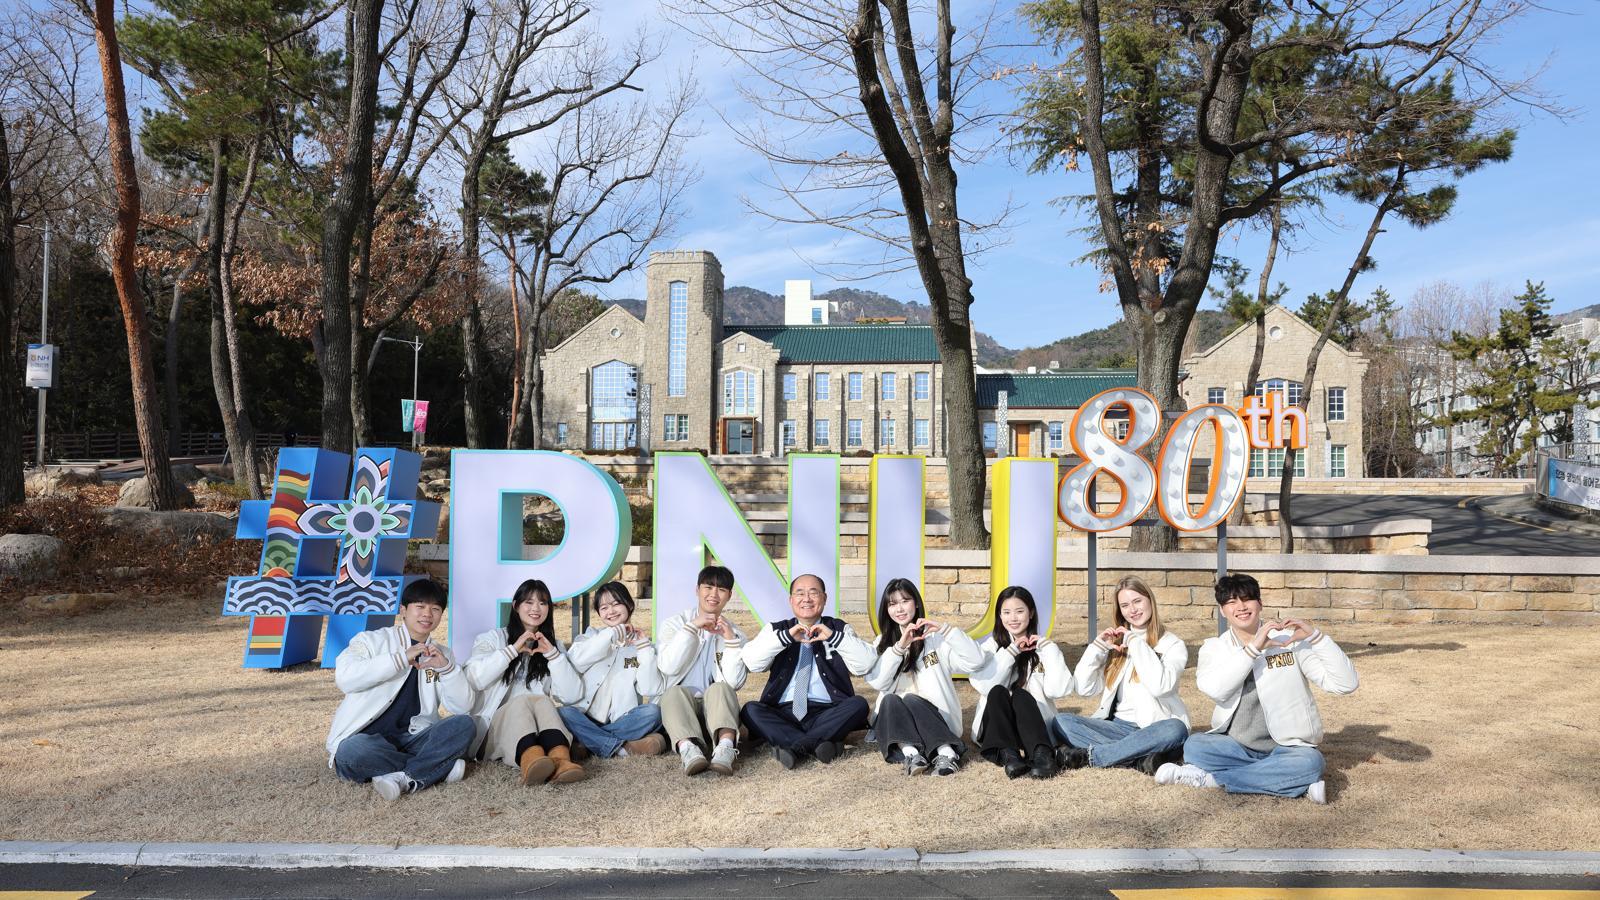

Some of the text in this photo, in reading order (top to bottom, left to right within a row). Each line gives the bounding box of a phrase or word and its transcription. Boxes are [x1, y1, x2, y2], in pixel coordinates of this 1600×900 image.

[623, 656, 640, 669] PN
[922, 650, 940, 669] PN
[1265, 651, 1295, 669] PNU
[425, 668, 441, 684] PN
